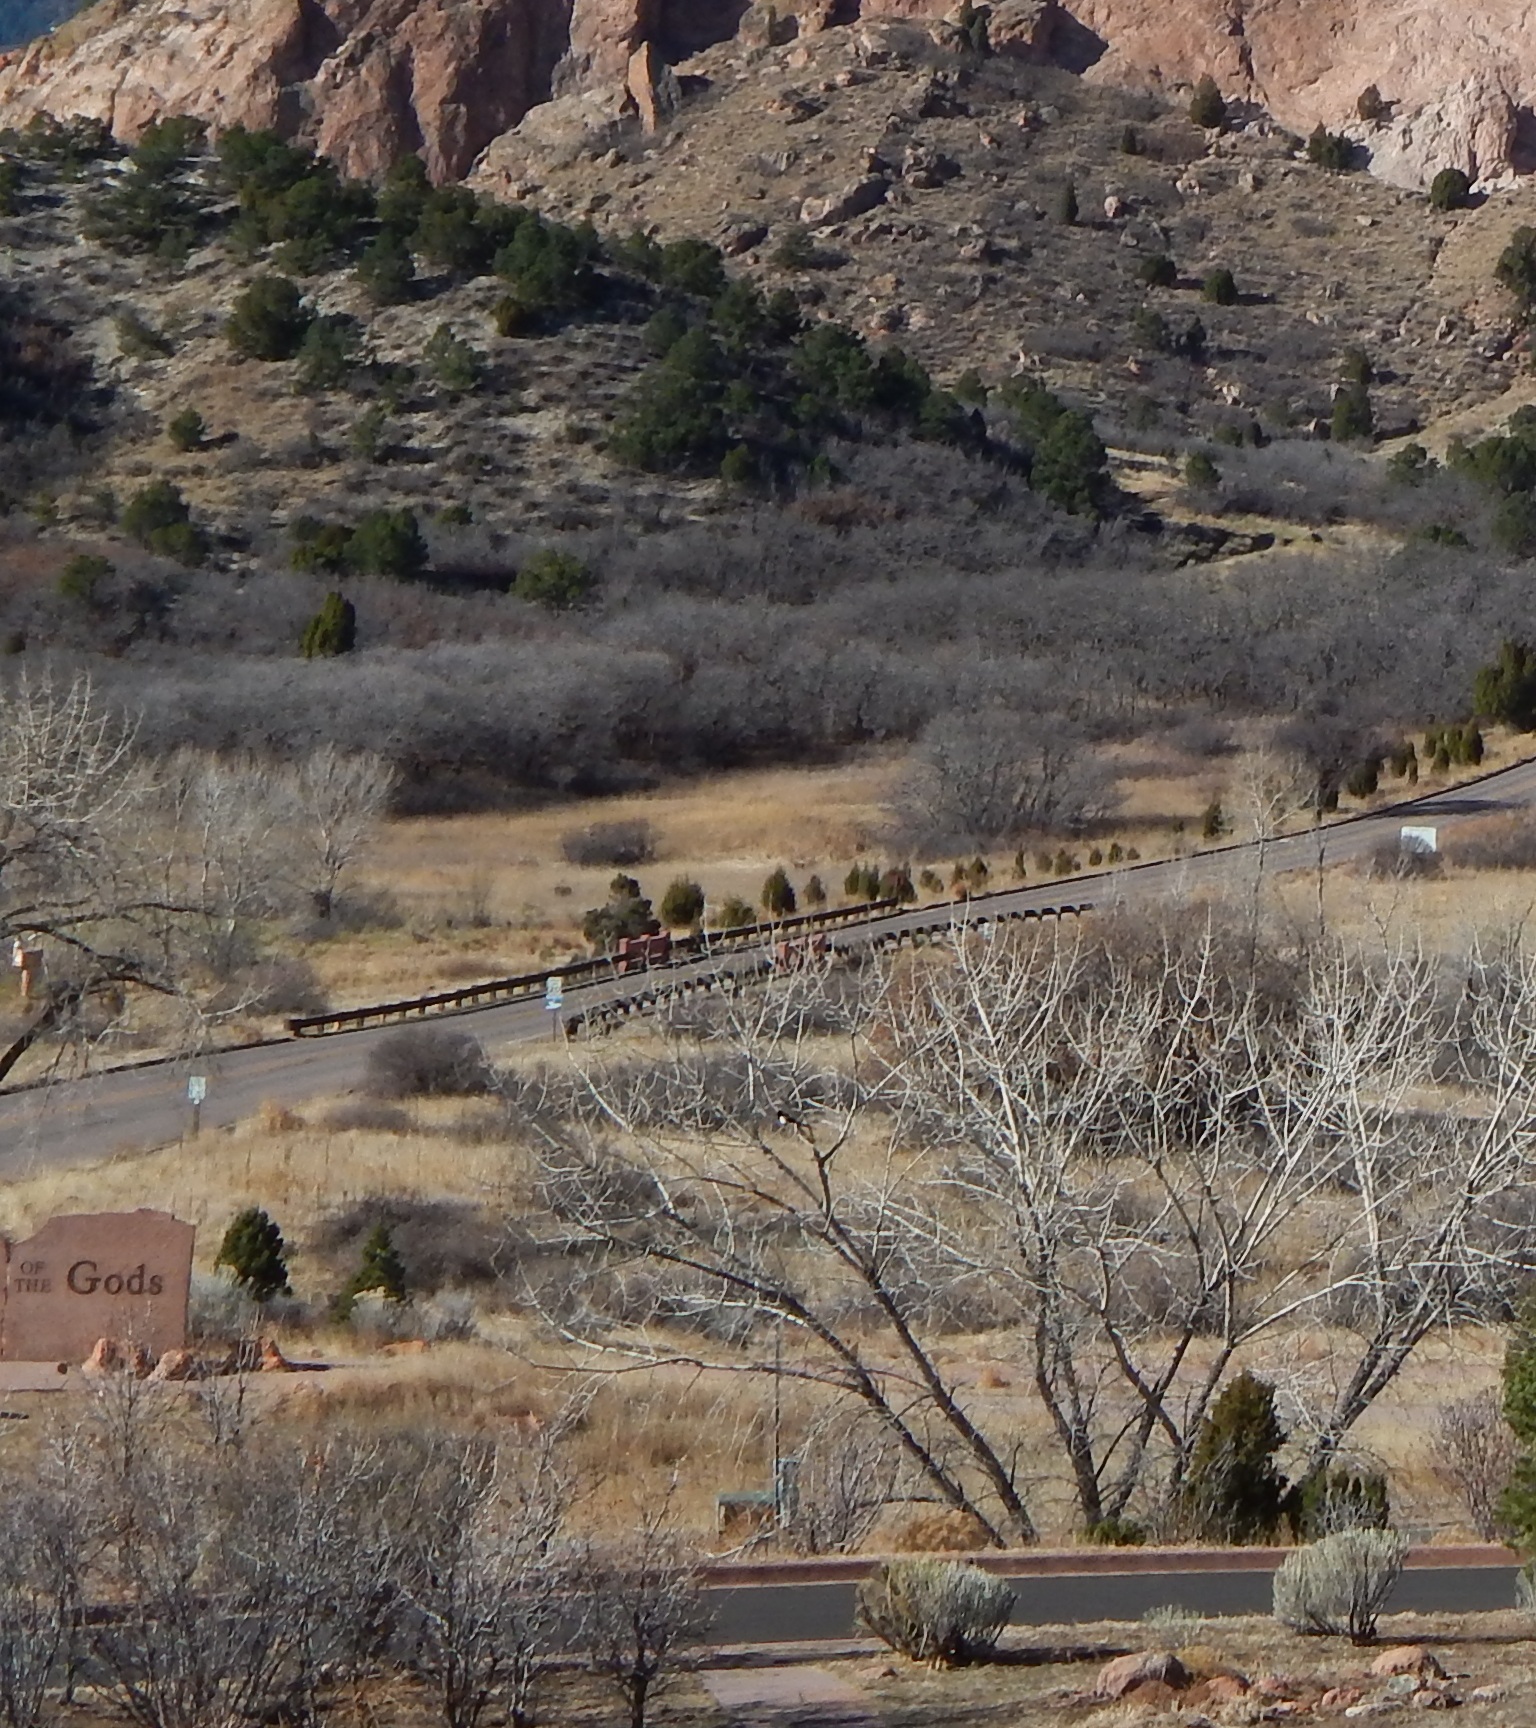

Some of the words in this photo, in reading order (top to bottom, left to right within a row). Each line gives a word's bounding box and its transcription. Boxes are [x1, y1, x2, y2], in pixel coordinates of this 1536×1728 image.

[20, 1260, 45, 1275] OF
[67, 1260, 163, 1295] Gods
[14, 1278, 51, 1293] THE
